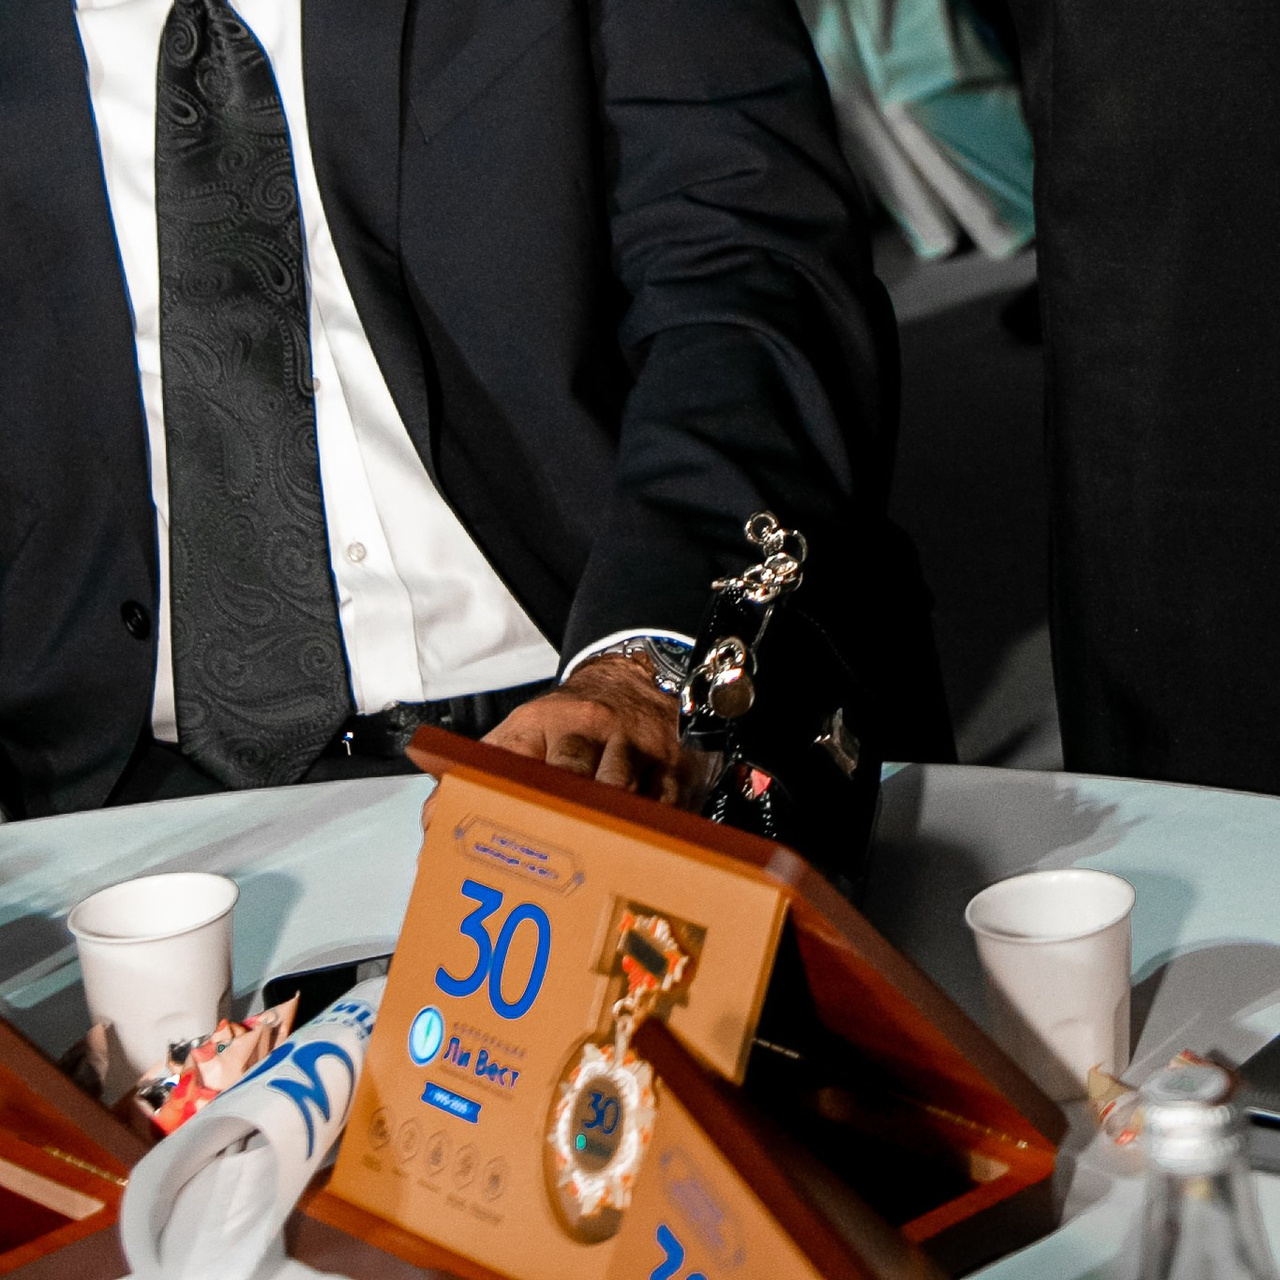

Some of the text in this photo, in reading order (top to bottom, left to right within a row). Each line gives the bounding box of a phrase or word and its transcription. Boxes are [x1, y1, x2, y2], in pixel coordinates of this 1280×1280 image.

[434, 878, 551, 1020] 30
[442, 1036, 471, 1069] Ли
[584, 1092, 620, 1135] 30
